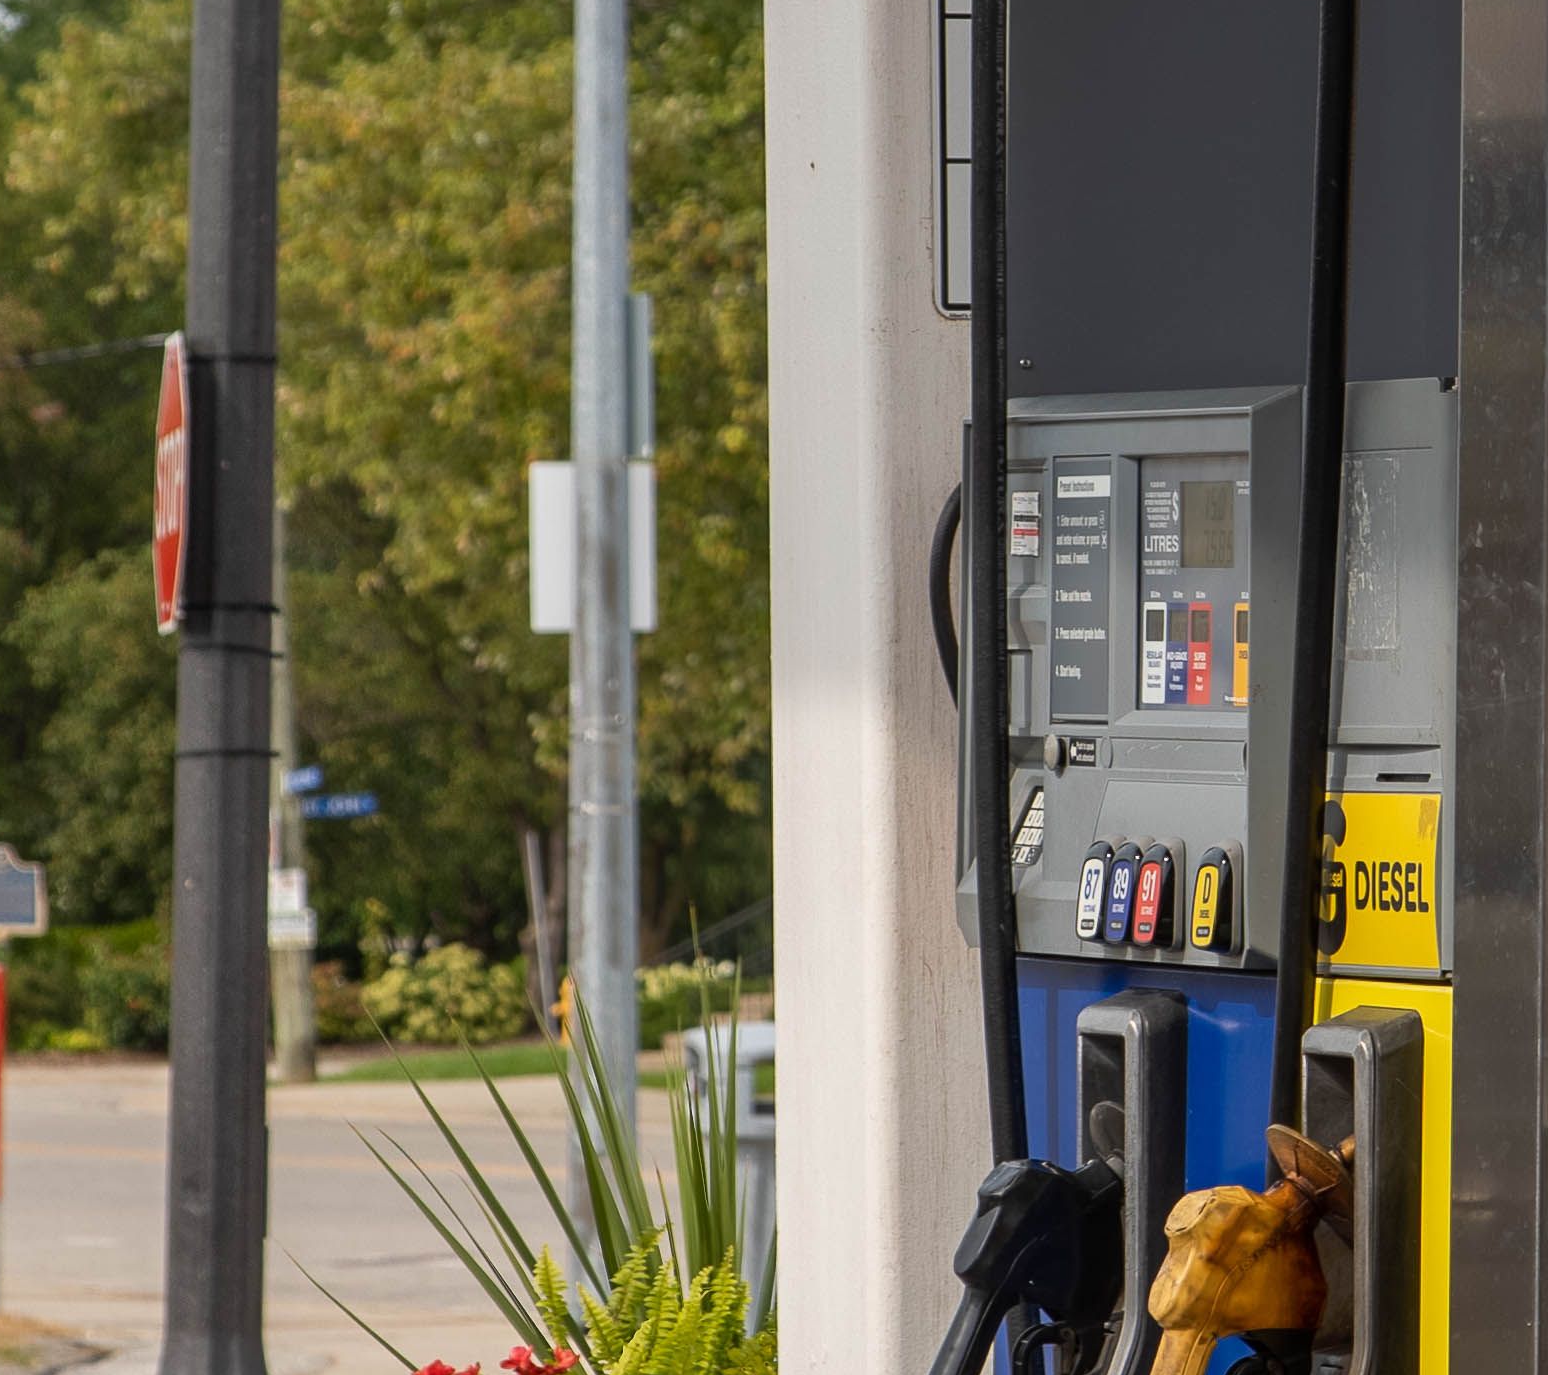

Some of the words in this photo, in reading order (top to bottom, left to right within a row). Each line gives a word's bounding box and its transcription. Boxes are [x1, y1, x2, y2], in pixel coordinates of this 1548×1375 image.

[155, 427, 184, 539] STOP
[1172, 491, 1179, 523] $
[1144, 535, 1179, 552] LITRES
[1084, 868, 1100, 900] 87
[1112, 867, 1129, 900] 89
[1142, 870, 1156, 903] 91
[1203, 873, 1211, 904] D
[1355, 861, 1429, 913] DIESEL
